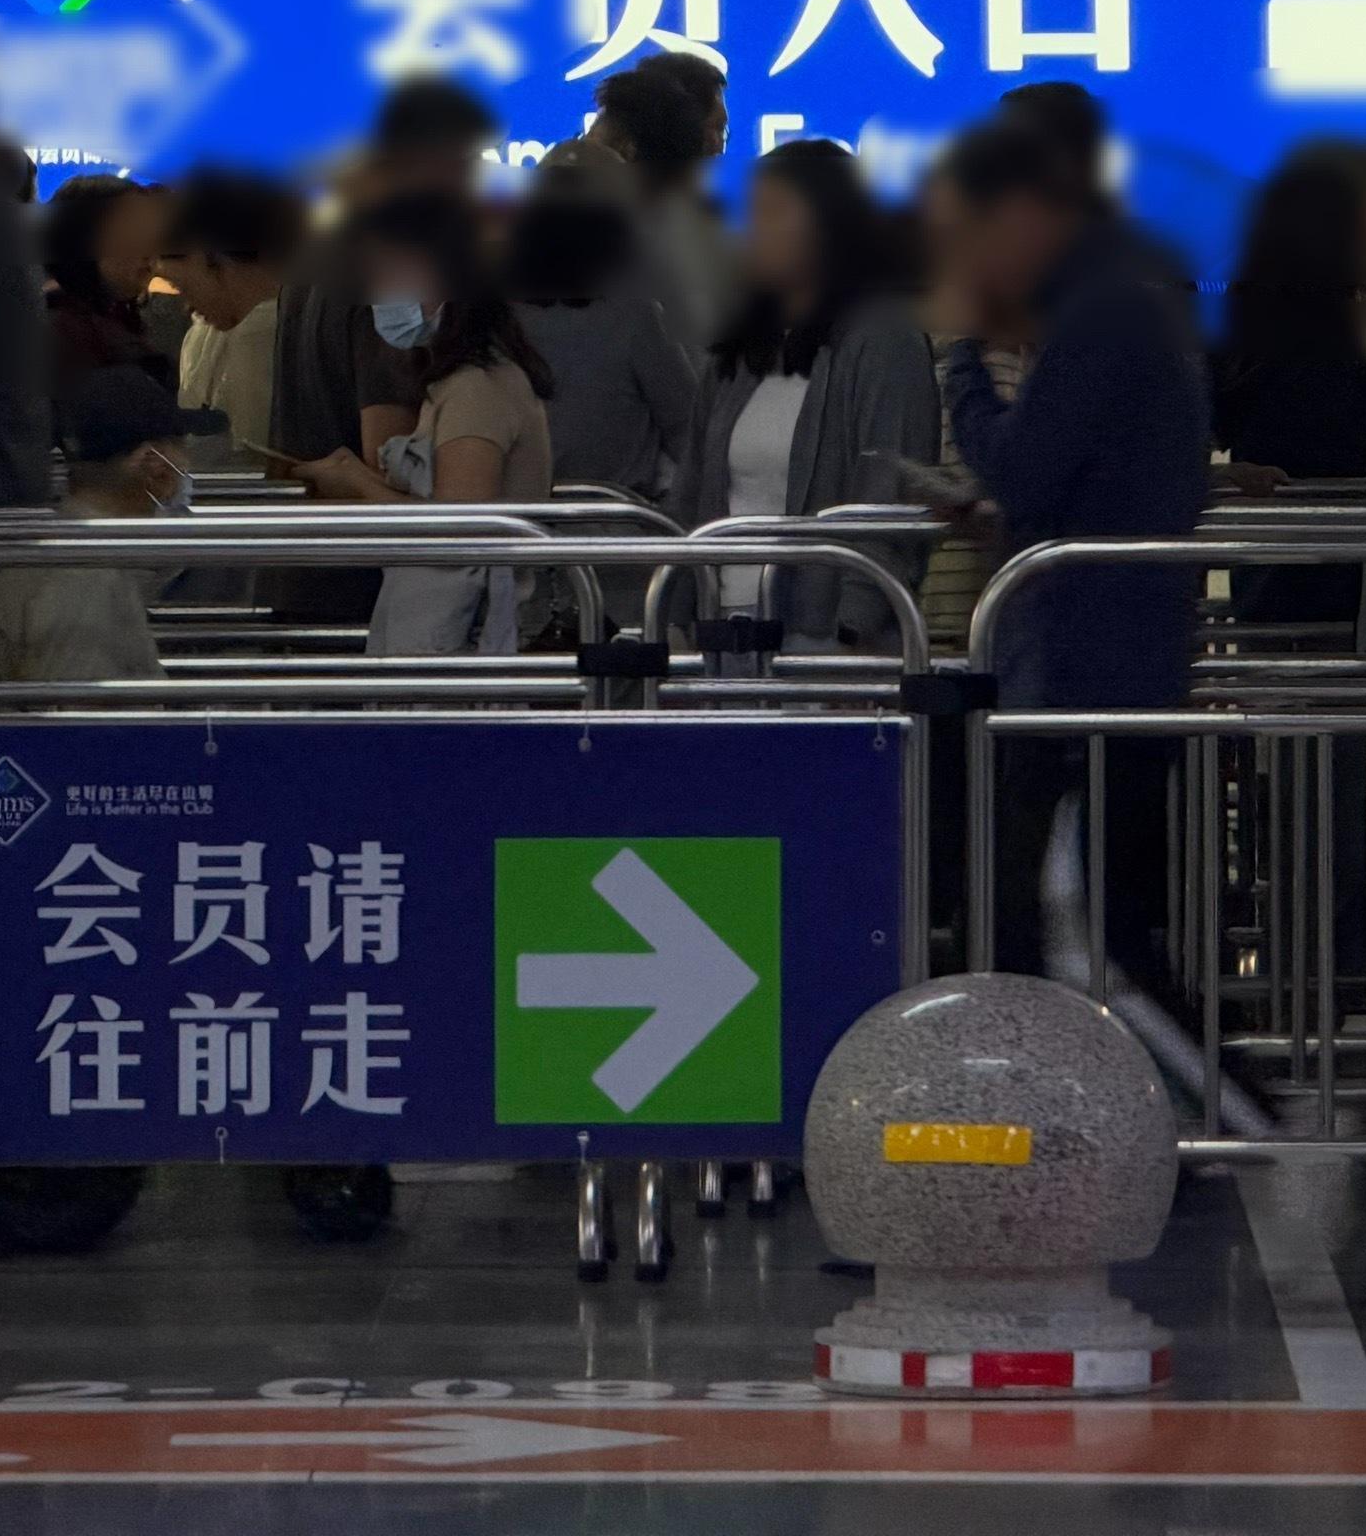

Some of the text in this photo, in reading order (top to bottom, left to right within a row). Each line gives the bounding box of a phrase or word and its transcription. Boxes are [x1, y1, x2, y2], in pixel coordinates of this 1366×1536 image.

[65, 801, 214, 816] Life is Better in the Club
[33, 840, 406, 966] 会员请
[35, 990, 412, 1117] 往前走
